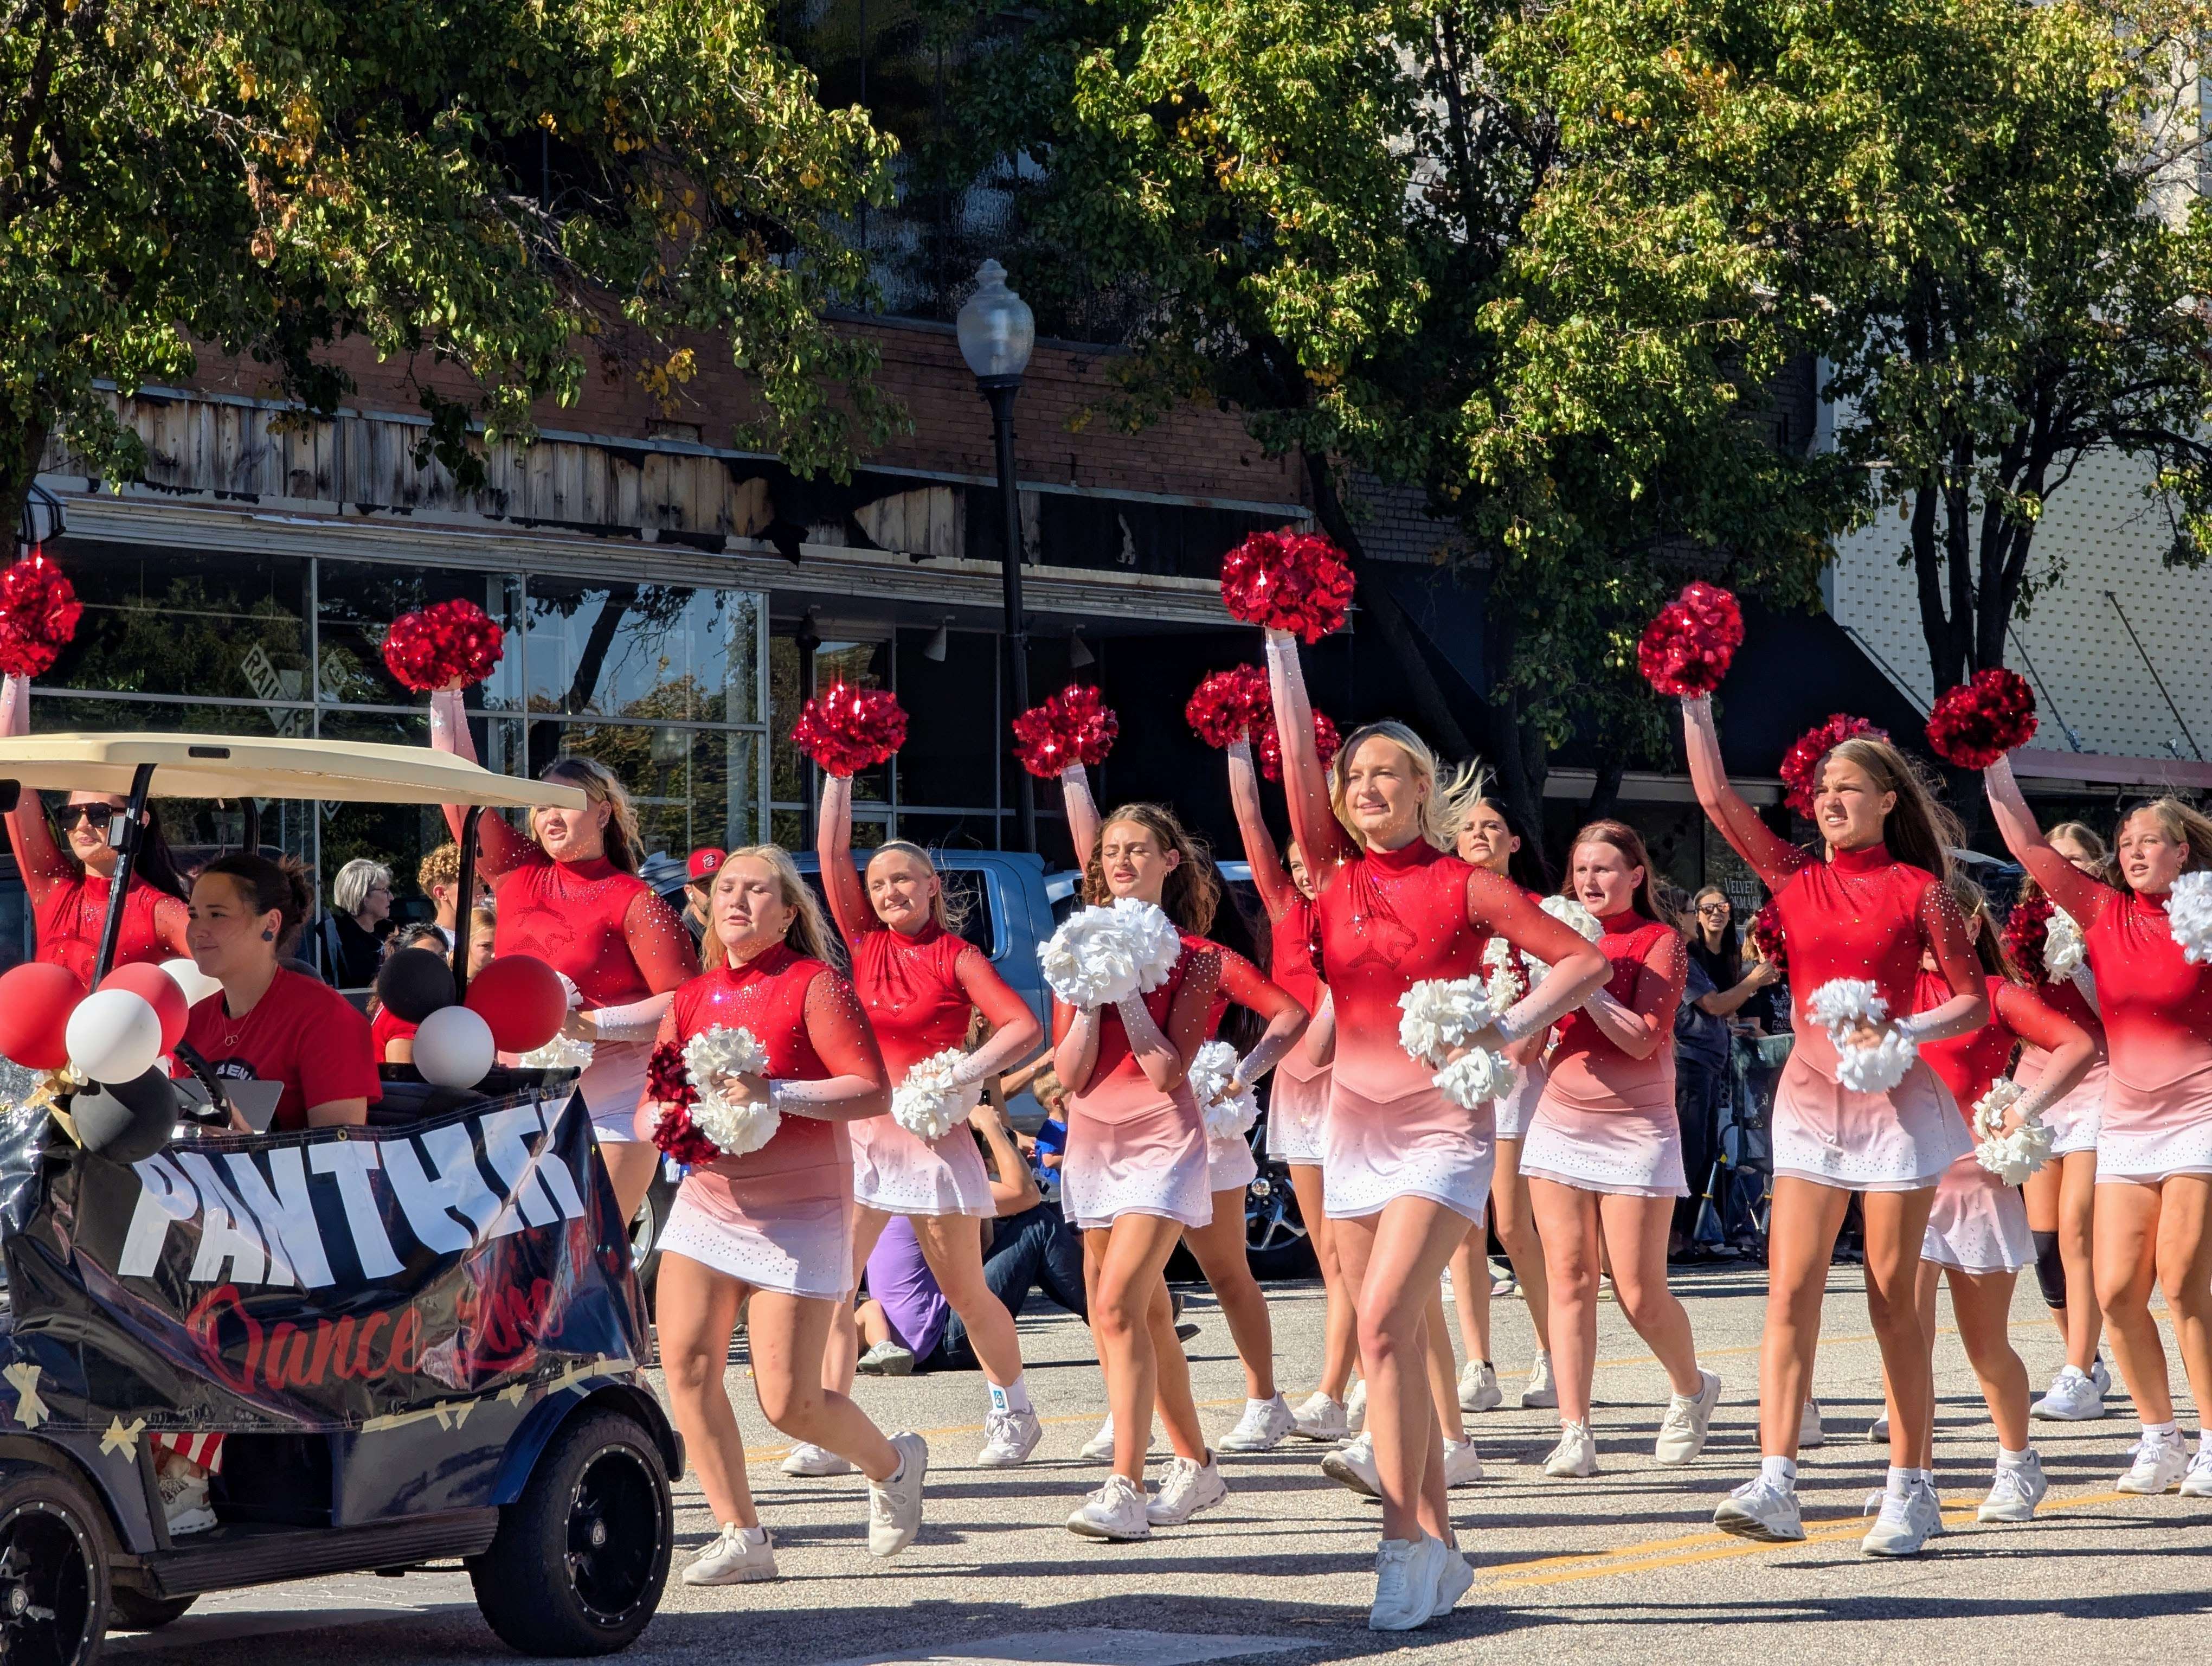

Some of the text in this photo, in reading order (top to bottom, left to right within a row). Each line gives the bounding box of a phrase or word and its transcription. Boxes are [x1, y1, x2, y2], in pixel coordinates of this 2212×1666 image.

[1724, 877, 1754, 894] VELVET
[1729, 895, 1762, 909] KMARK
[185, 1284, 426, 1394] Dance
